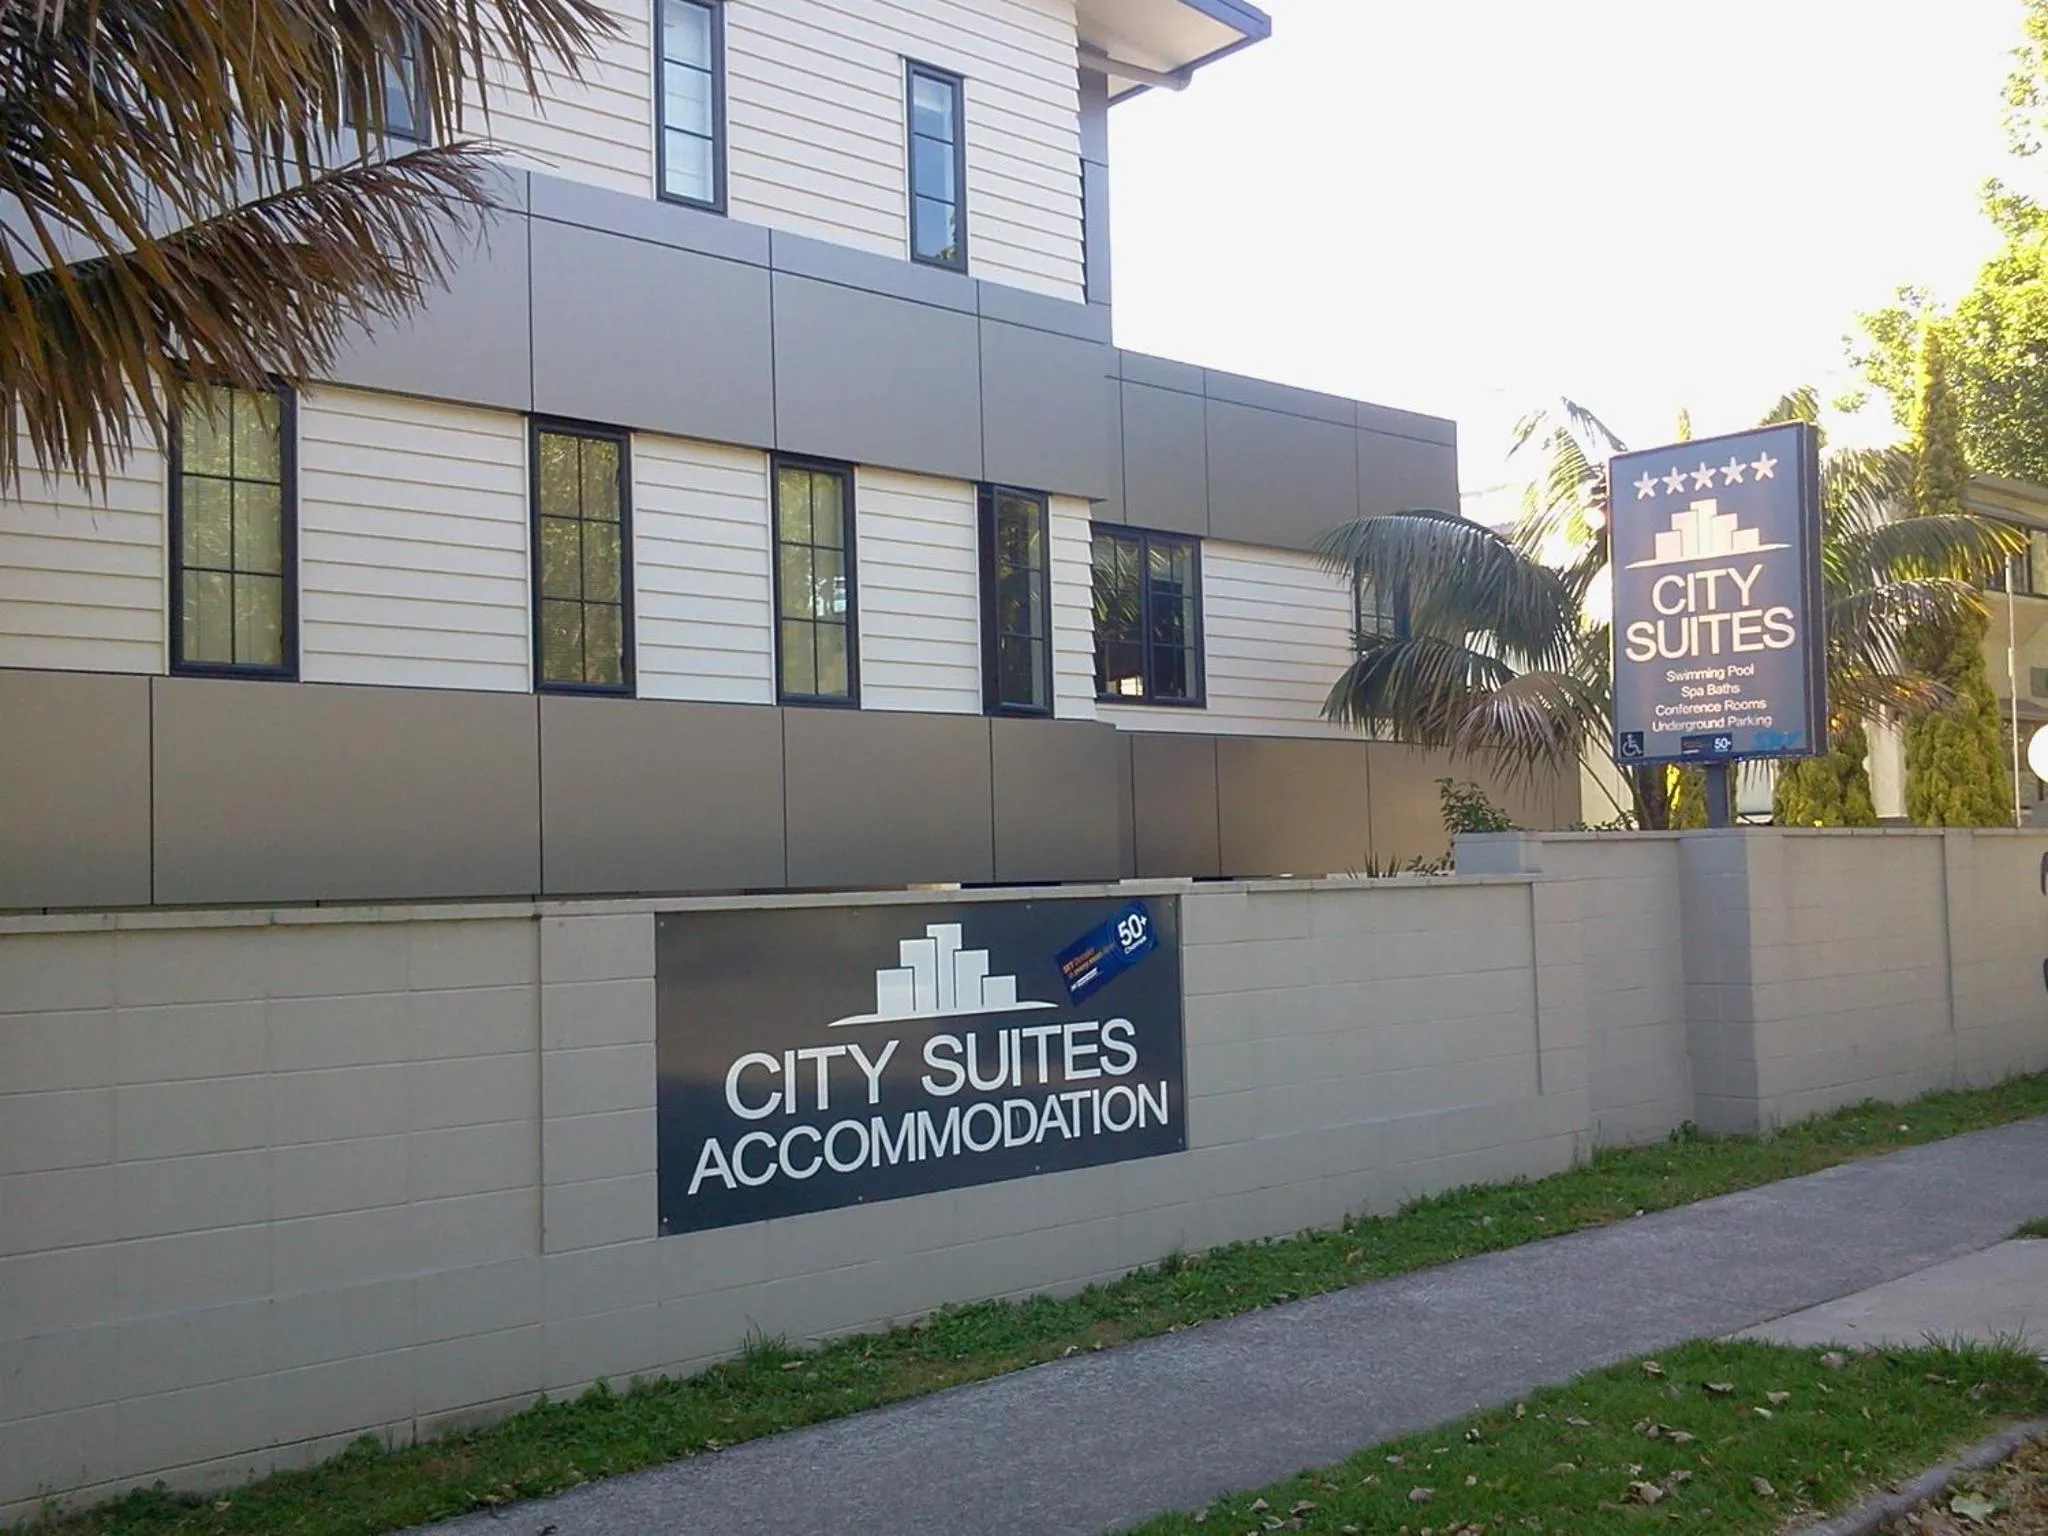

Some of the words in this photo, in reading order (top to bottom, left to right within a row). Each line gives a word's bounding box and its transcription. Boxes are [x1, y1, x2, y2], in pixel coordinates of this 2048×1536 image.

[1652, 564, 1763, 616] CITY
[1625, 606, 1796, 663] SUITES
[1666, 668, 1725, 683] Swimming
[1727, 664, 1754, 677] Pool
[1655, 702, 1721, 717] Conference
[1724, 699, 1767, 712] Rooms
[1681, 686, 1704, 699] Spa
[1706, 684, 1740, 696] Baths
[1652, 718, 1725, 733] Underground
[1727, 715, 1773, 728] Parking
[1117, 913, 1148, 947] 50+
[724, 1039, 900, 1121] CITY
[921, 1018, 1139, 1097] SUITES
[687, 1080, 1169, 1196] ACCOMMODATION
